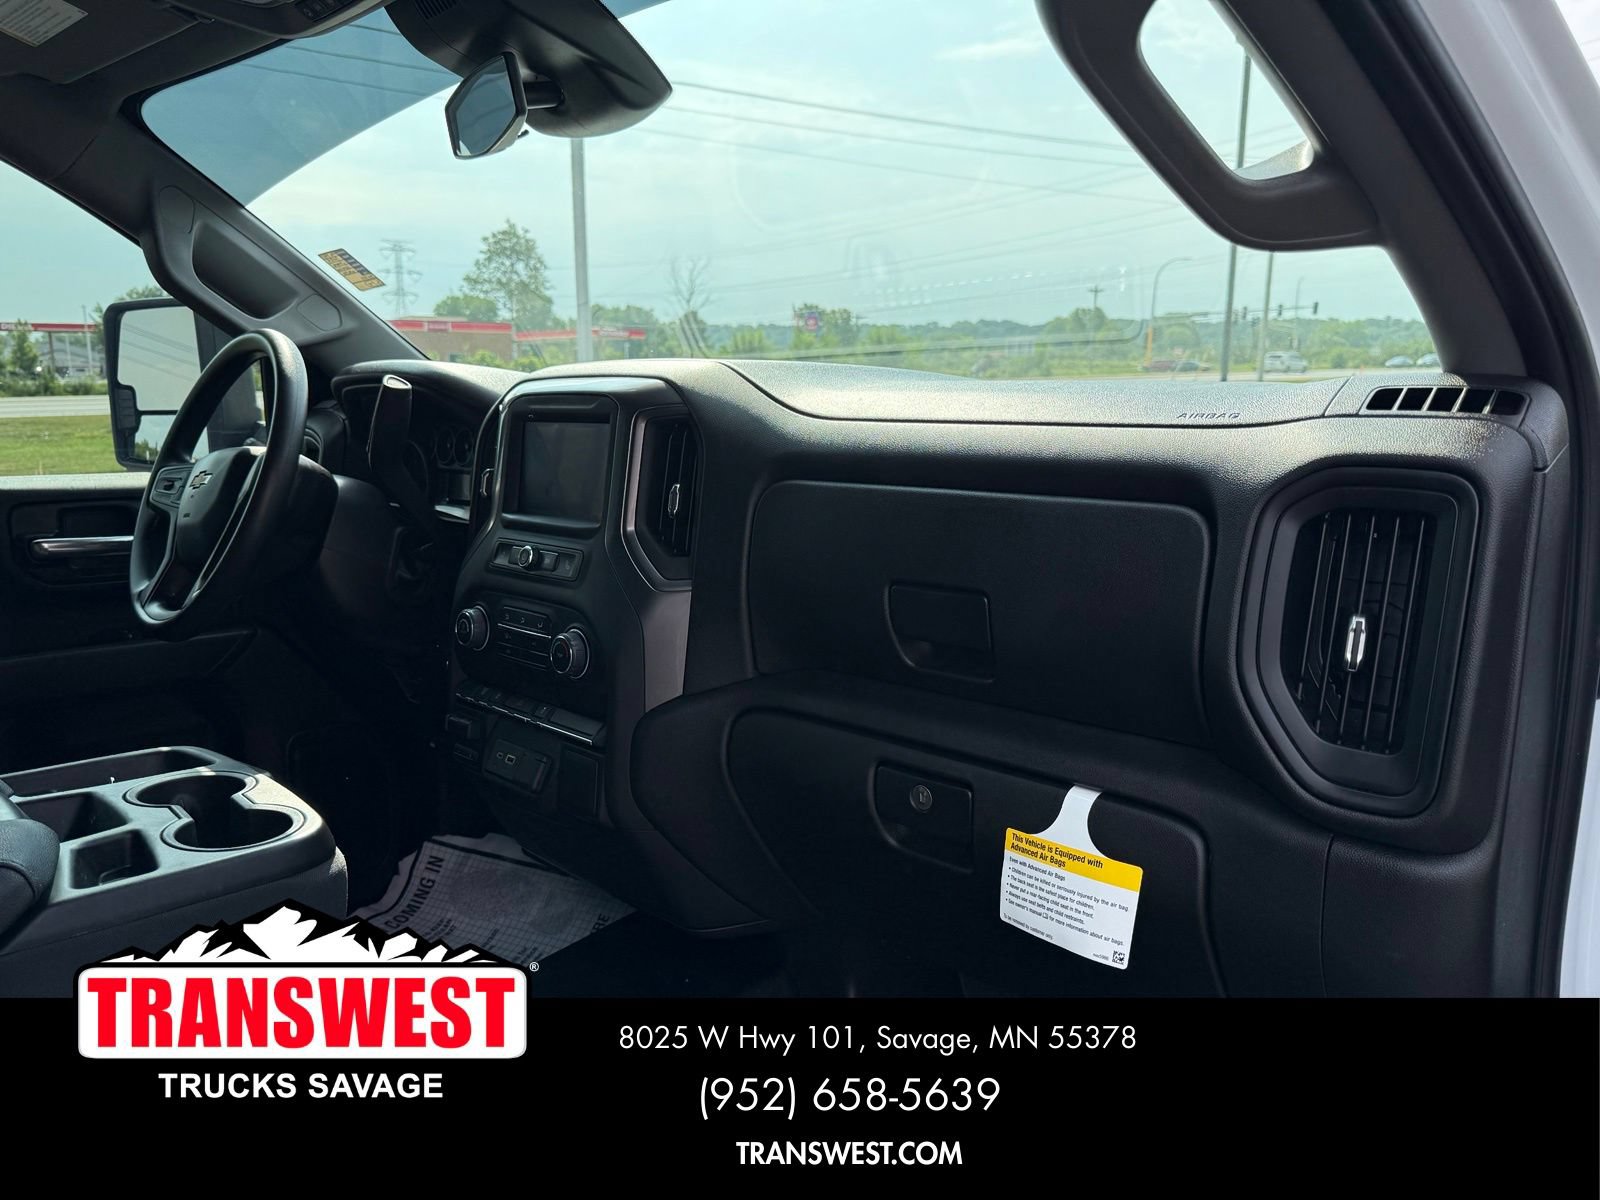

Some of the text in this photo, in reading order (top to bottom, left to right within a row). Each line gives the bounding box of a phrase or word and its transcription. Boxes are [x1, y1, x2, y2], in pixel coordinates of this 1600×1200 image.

[1011, 843, 1066, 868] Advanced Air Bags
[1012, 833, 1103, 868] This Vehicle is Equipped with
[1028, 864, 1047, 875] Advanced
[384, 855, 445, 929] COMING IN
[1009, 891, 1020, 899] Always
[1012, 867, 1026, 876] Children
[1057, 884, 1076, 895] seriously
[1077, 892, 1093, 901] injured
[1046, 889, 1057, 897] safest
[1029, 908, 1042, 916] manual
[1066, 922, 1089, 935] information
[1090, 931, 1103, 940] about
